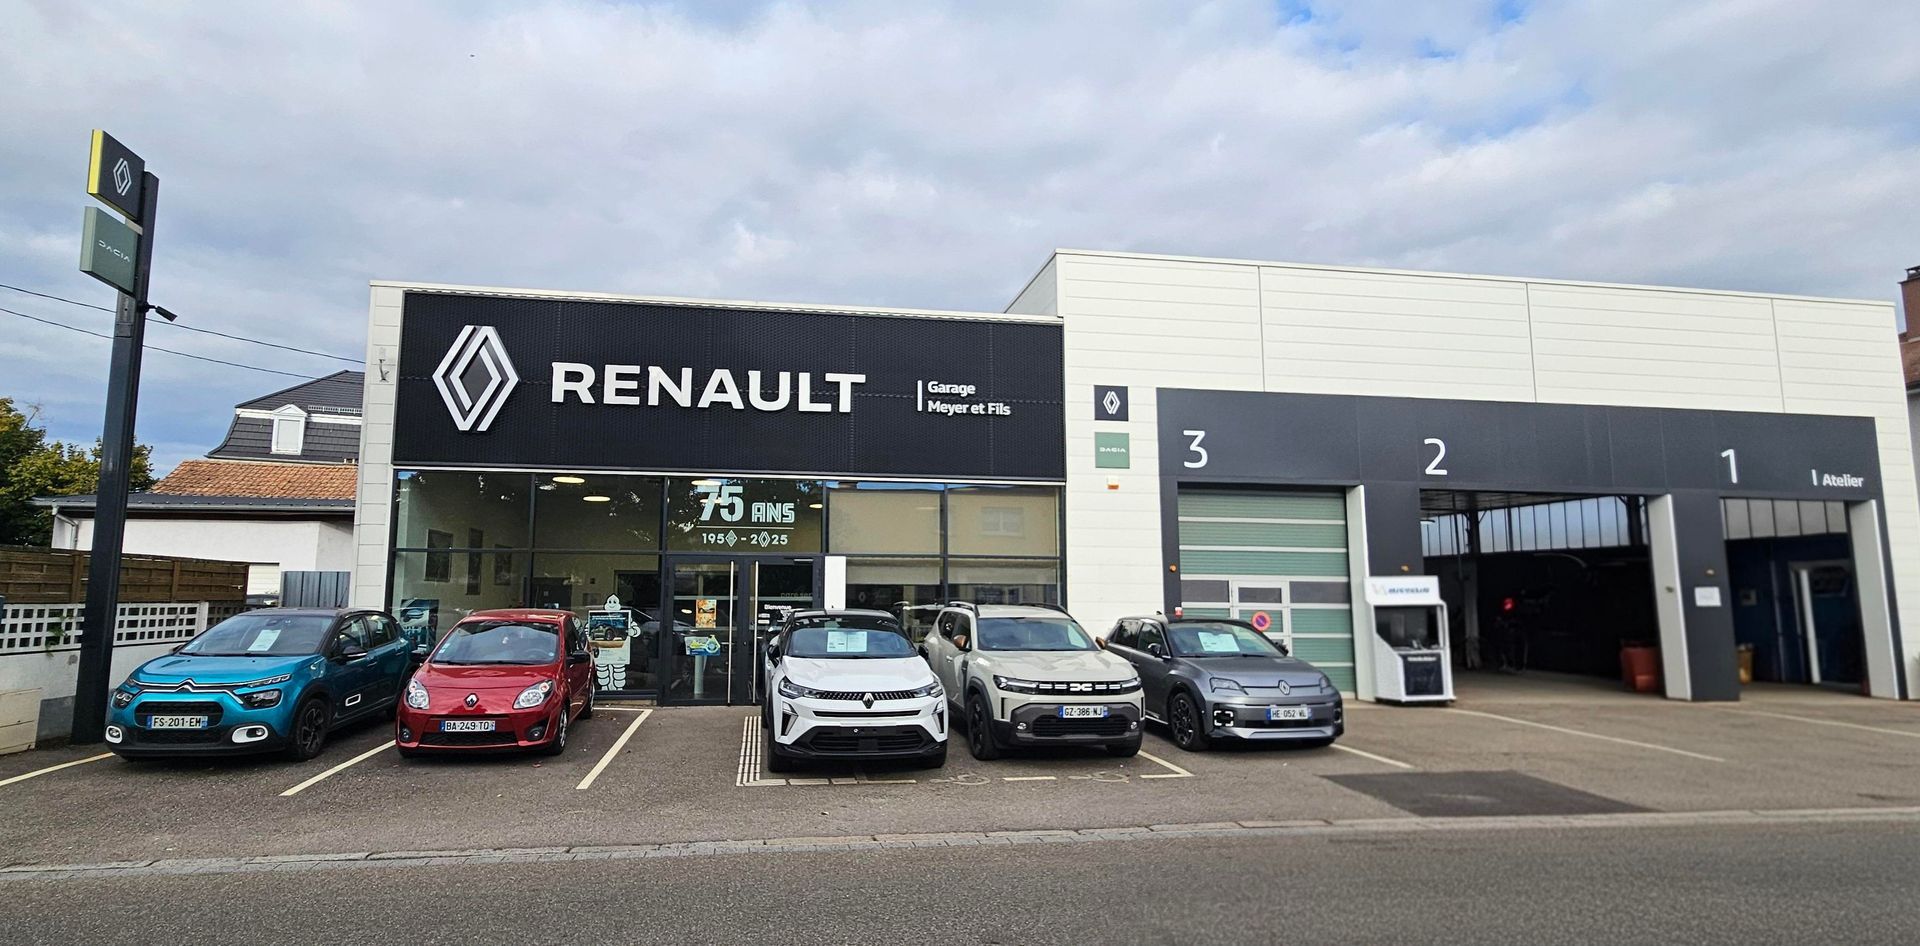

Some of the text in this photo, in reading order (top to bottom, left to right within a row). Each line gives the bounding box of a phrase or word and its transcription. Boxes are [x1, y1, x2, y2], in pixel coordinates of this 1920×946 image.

[98, 239, 131, 263] DACIA
[551, 361, 866, 413] RENAULT
[927, 380, 976, 398] Garage
[927, 400, 1011, 417] Meyer et Fils
[1183, 430, 1208, 469] 3
[1424, 438, 1448, 476] 2
[1720, 448, 1738, 484] 1
[1822, 473, 1864, 488] Atelier
[697, 484, 795, 523] 75 ANS
